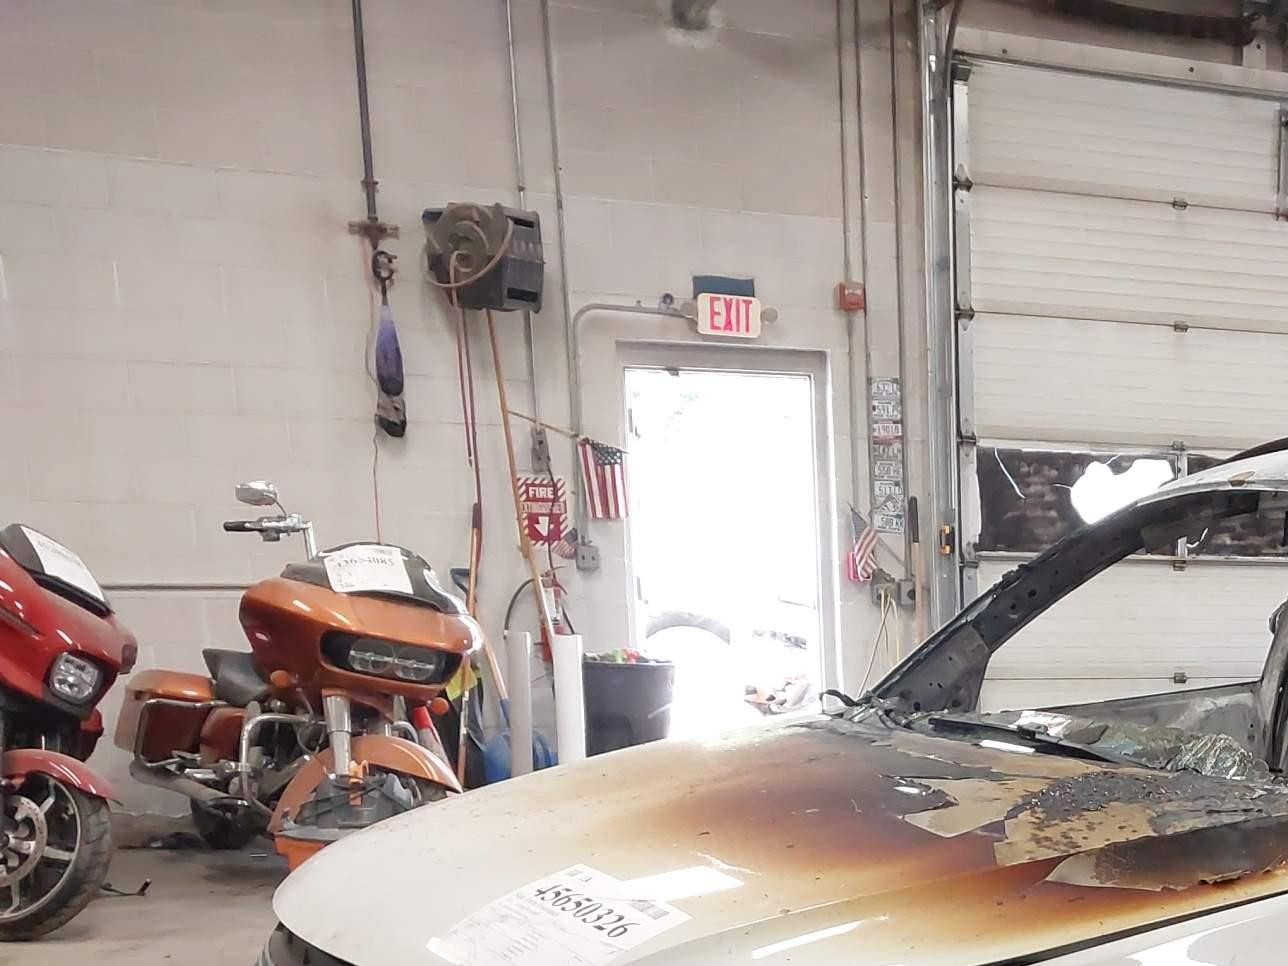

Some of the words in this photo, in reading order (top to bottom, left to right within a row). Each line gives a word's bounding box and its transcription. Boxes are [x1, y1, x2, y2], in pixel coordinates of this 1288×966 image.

[709, 296, 752, 333] EXIT
[528, 486, 554, 498] FIRE
[534, 884, 641, 938] 45650326
